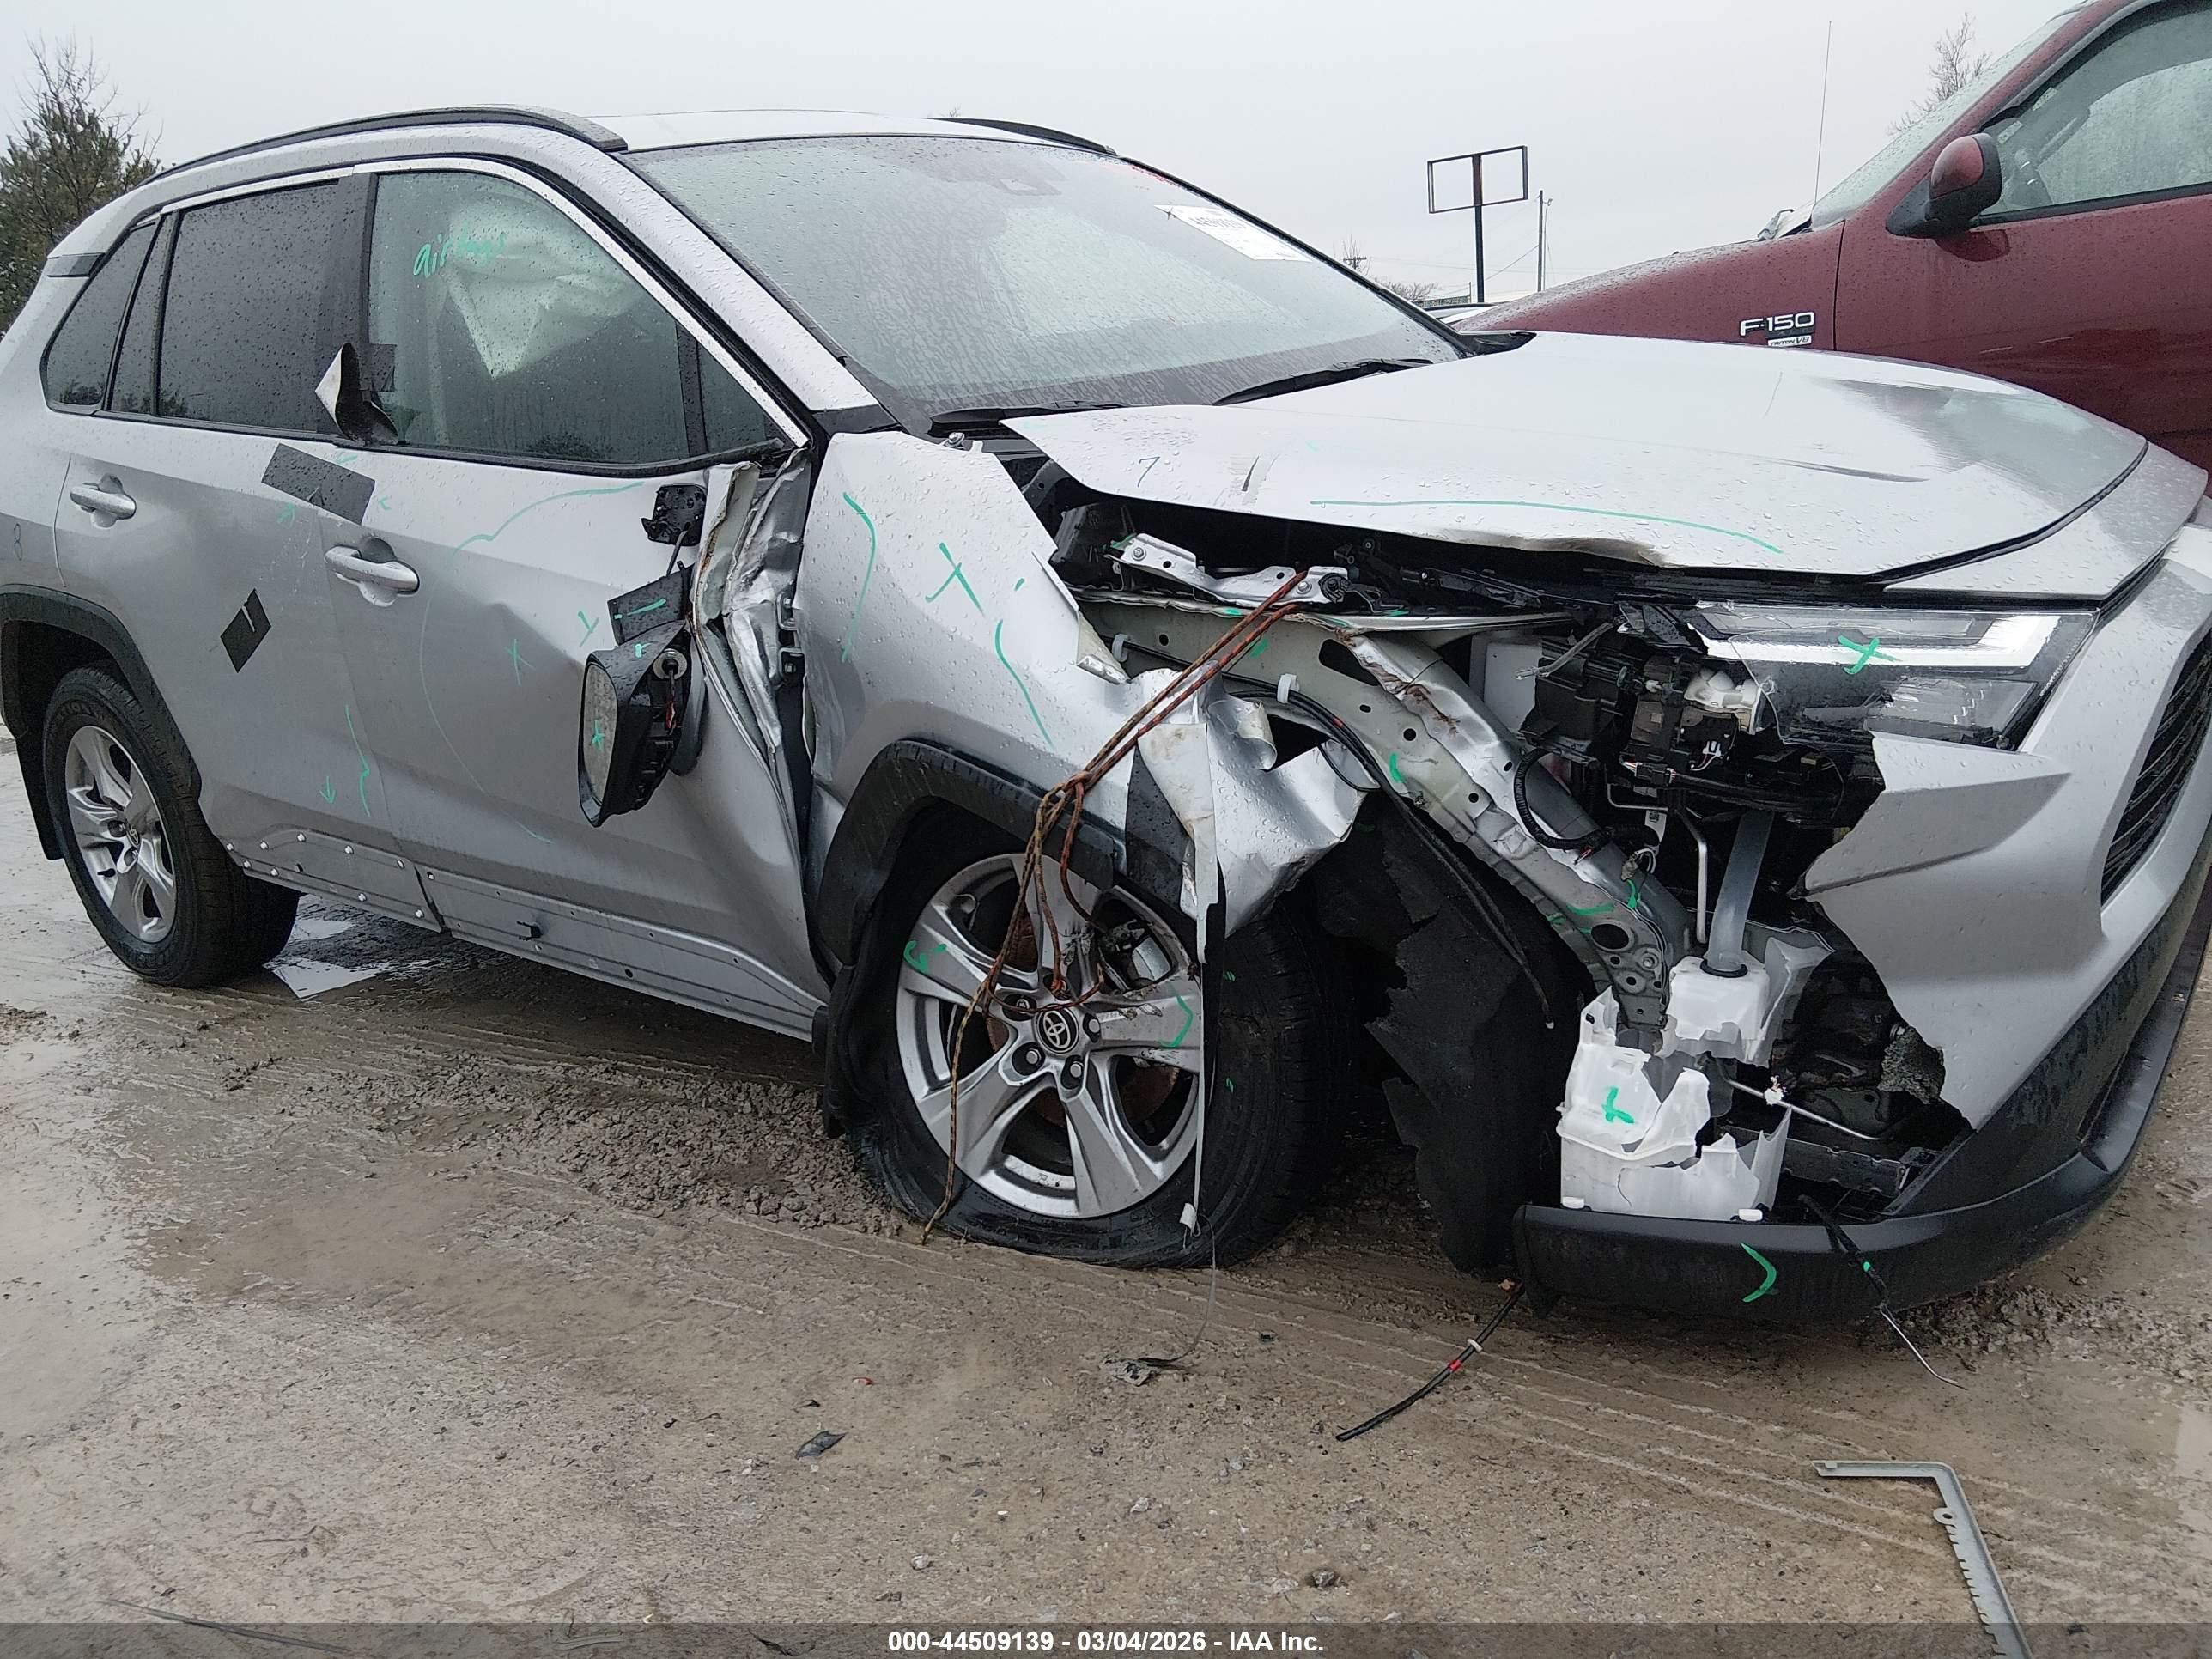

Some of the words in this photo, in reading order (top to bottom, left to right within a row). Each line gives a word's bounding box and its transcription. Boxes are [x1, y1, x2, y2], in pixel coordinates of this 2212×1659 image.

[1740, 311, 1814, 337] F-150
[1769, 338, 1796, 347] TRITON
[1796, 336, 1810, 344] V8
